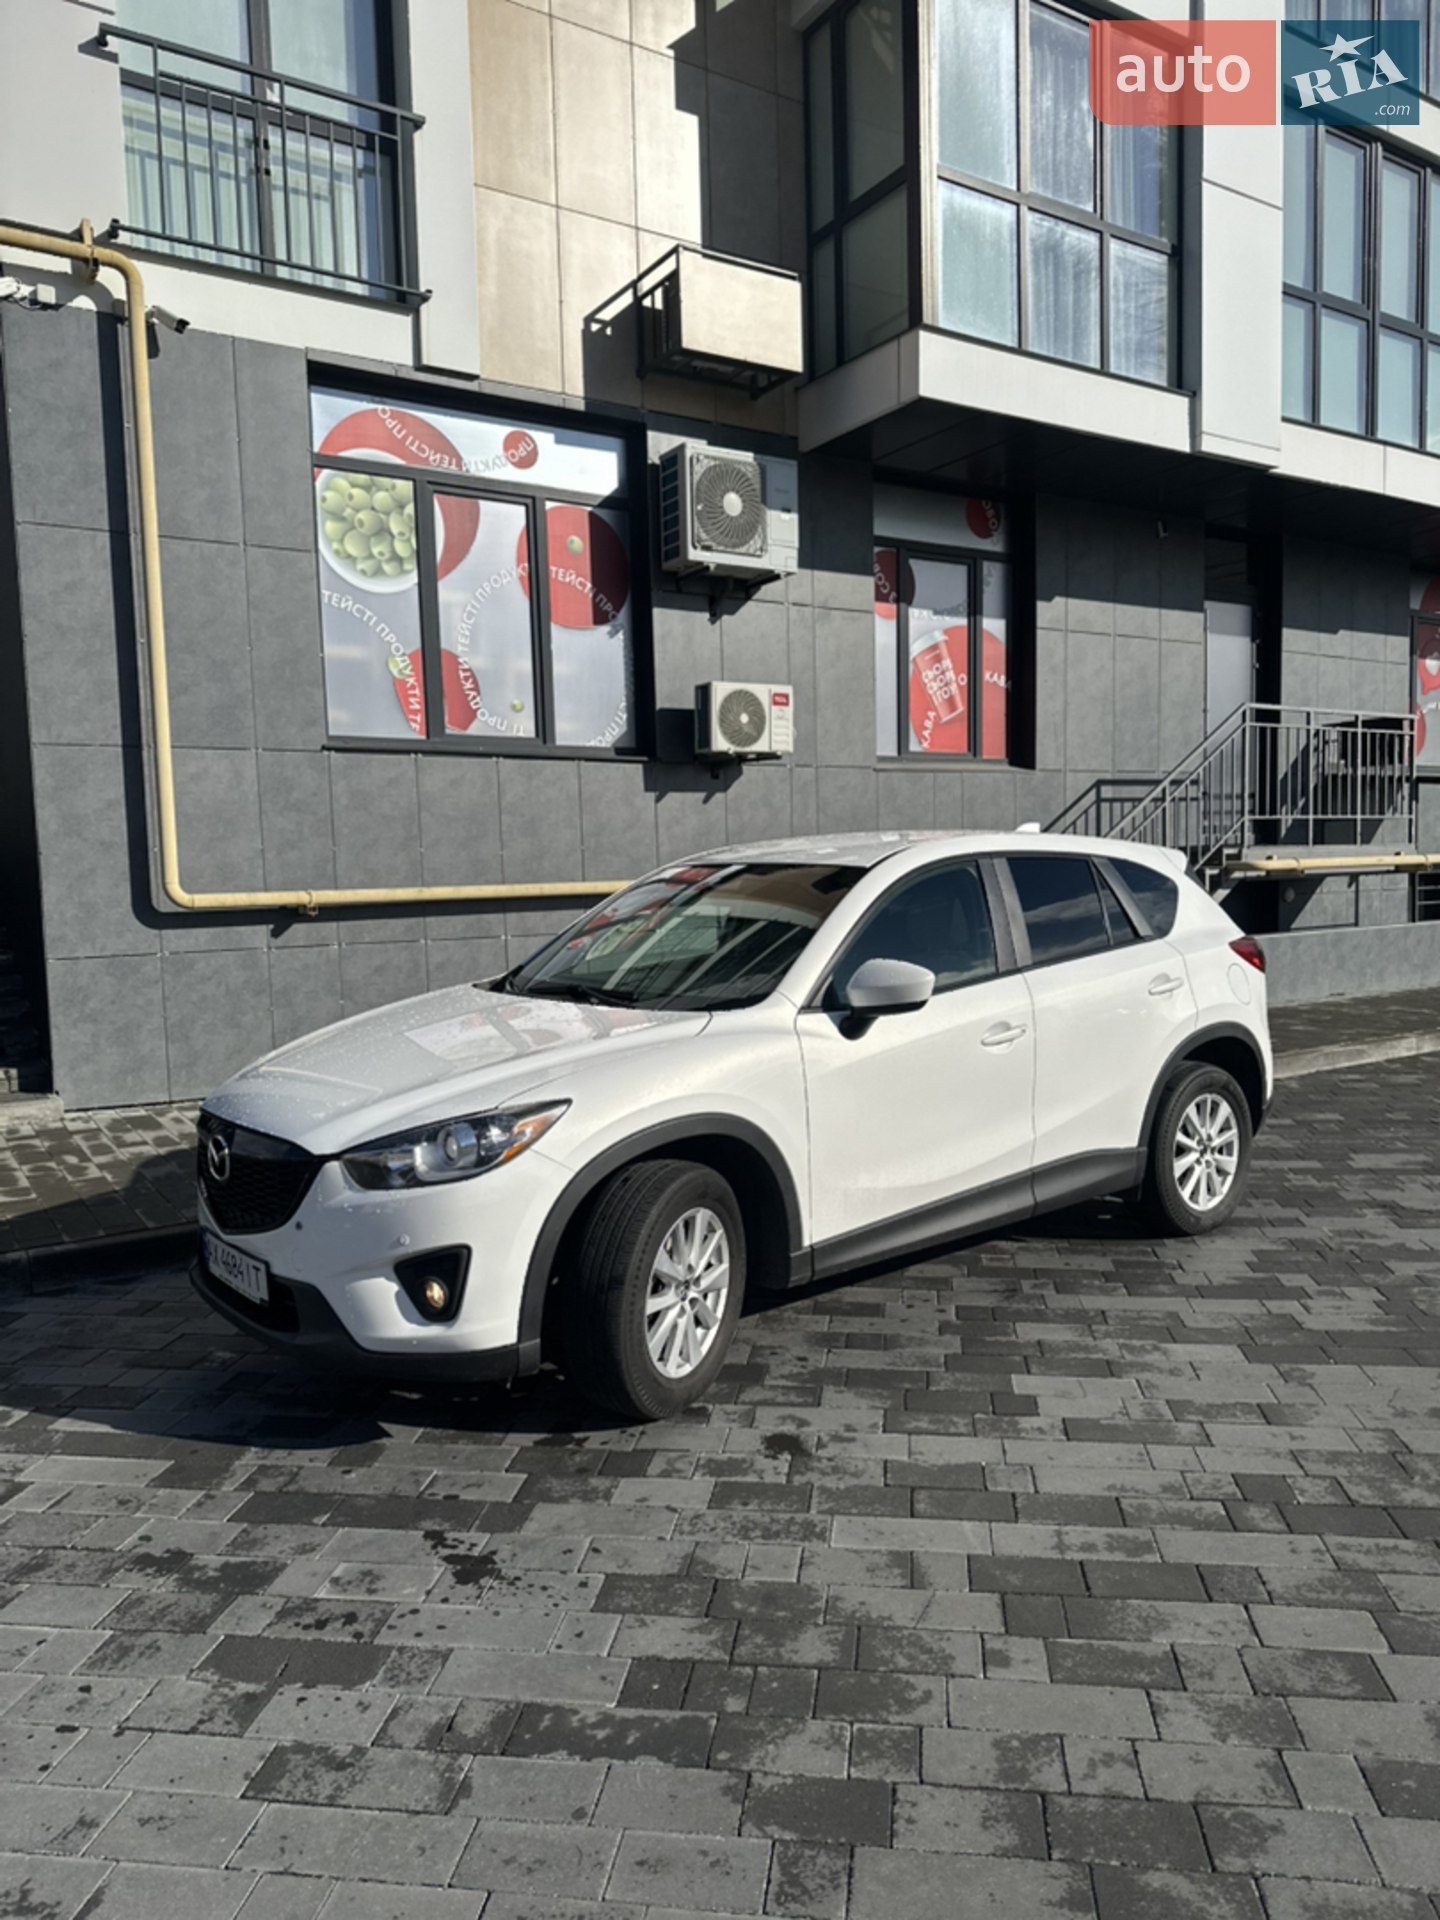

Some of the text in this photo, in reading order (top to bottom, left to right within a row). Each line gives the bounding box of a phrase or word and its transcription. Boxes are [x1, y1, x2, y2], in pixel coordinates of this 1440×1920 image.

[404, 434, 459, 471] ТЕЙСТІ
[549, 565, 597, 599] ТЕЙСТІ
[321, 588, 378, 627] ТЕЙСТІ
[375, 623, 422, 710] ПРОДУКТИ
[456, 599, 482, 653] ТЕЙСТІ
[457, 656, 508, 732] ПРОДУКТИ
